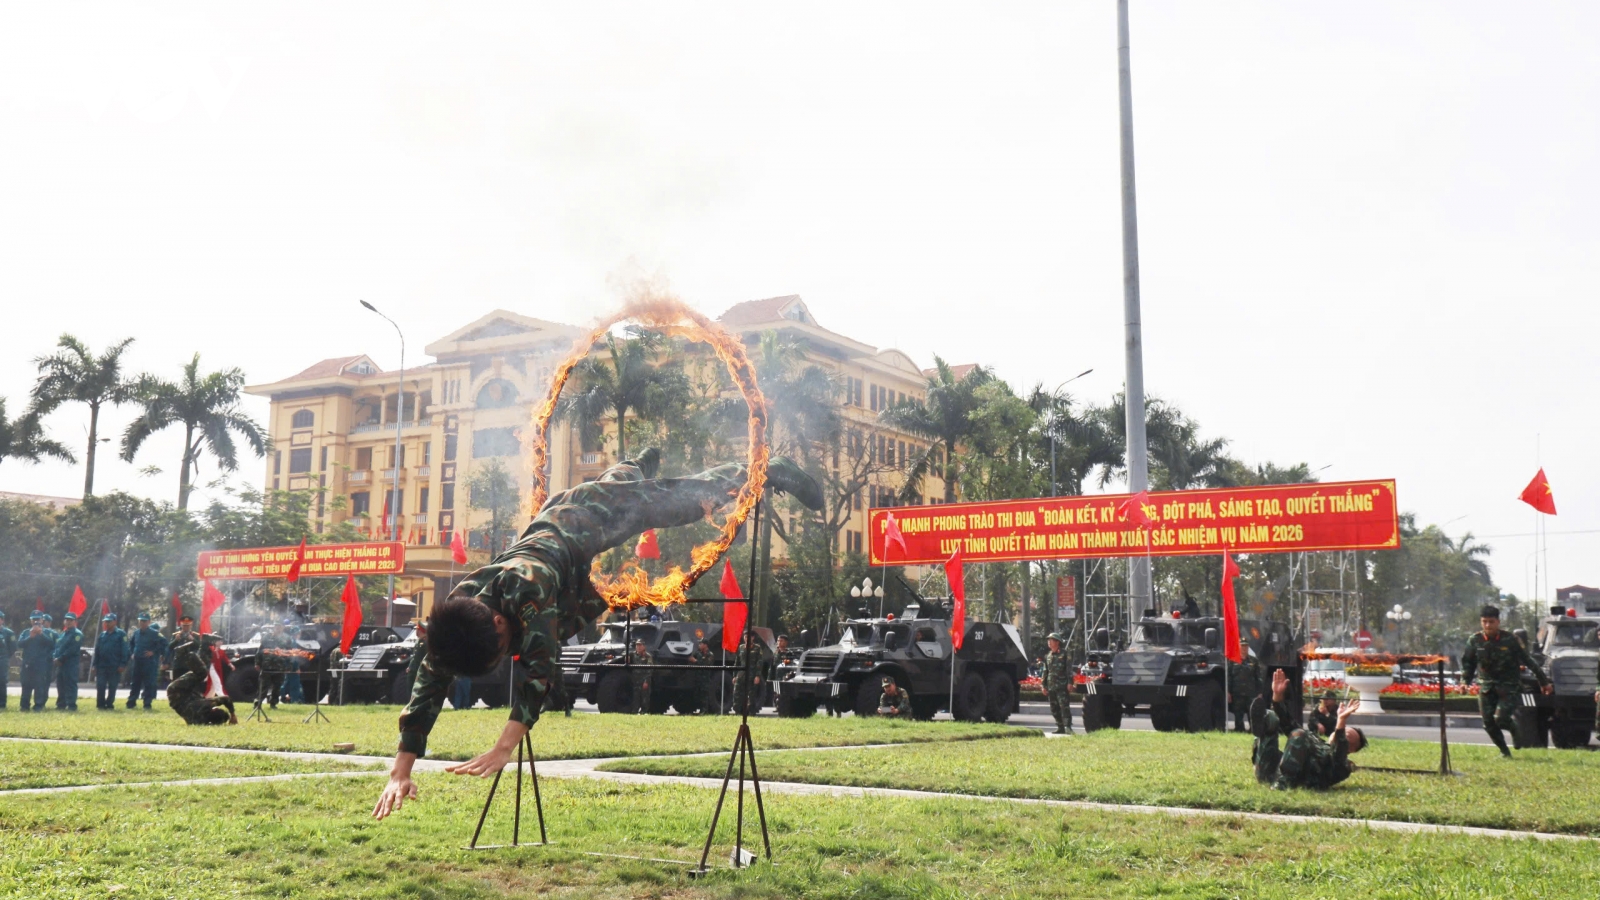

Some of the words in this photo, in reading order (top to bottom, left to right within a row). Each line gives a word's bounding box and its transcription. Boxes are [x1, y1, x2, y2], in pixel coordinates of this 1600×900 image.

[902, 517, 930, 536] MẠNH
[933, 514, 966, 531] PHONG
[969, 511, 994, 529] TRÀO
[997, 512, 1012, 528] THI
[1015, 511, 1036, 527] ĐUA
[1076, 503, 1098, 525] KẾT,
[1101, 501, 1115, 523] KỶ
[1163, 500, 1185, 523] ĐỘT
[1188, 498, 1216, 520] PHÁ,
[1219, 497, 1253, 518] SÁNG
[1256, 498, 1283, 520] TẠO,
[1286, 490, 1326, 516] QUYẾT
[941, 539, 962, 555] LLVT
[964, 533, 987, 553] TỈNH
[990, 531, 1021, 554] QUYẾT
[1023, 532, 1046, 550] TÂM
[1049, 530, 1078, 549] HOÀN
[1081, 528, 1117, 548] THÀNH
[1120, 525, 1149, 547] XUẤT
[1152, 523, 1175, 546] SẮC
[1178, 524, 1218, 548] NHIỆM
[1220, 526, 1236, 547] VỤ
[1240, 522, 1269, 543] NĂM
[1272, 524, 1304, 542] 2026
[323, 562, 338, 572] CAO
[360, 559, 377, 570] NĂM
[378, 560, 396, 570] 2026
